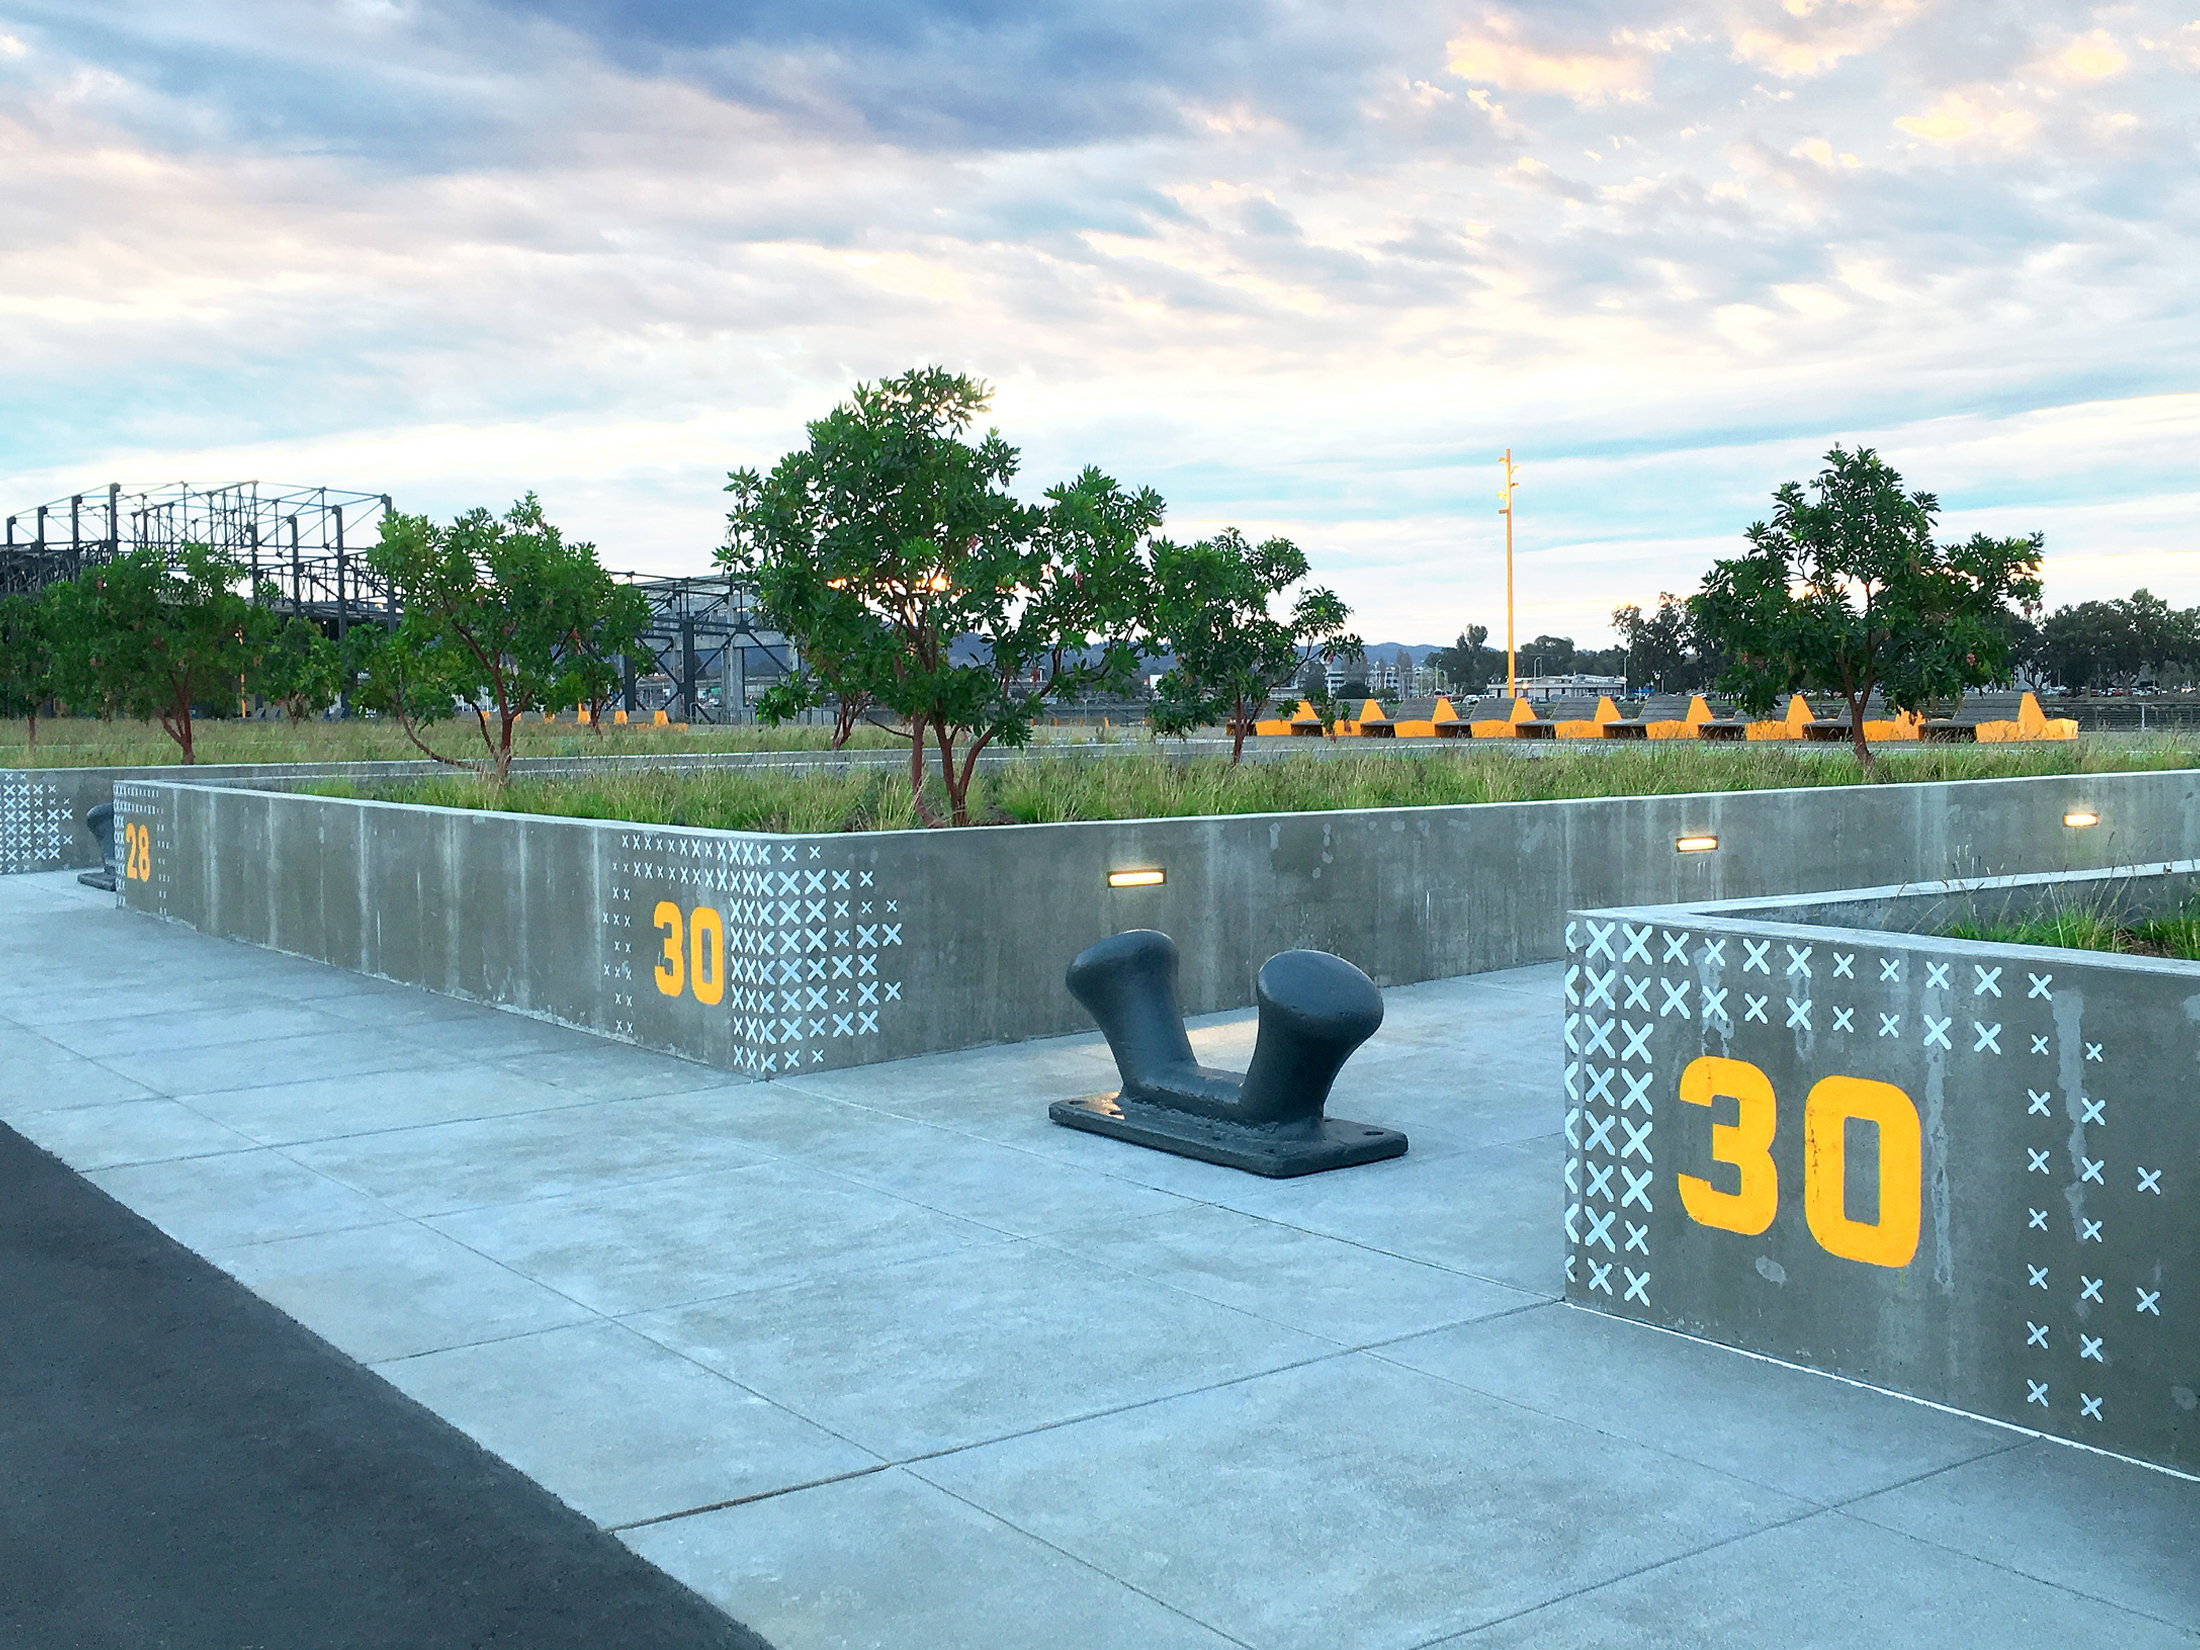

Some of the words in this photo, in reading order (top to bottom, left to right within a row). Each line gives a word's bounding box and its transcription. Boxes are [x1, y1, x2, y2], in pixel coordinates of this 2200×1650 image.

[126, 823, 150, 882] 28
[653, 901, 725, 1005] 30
[1677, 1055, 1922, 1268] 30
